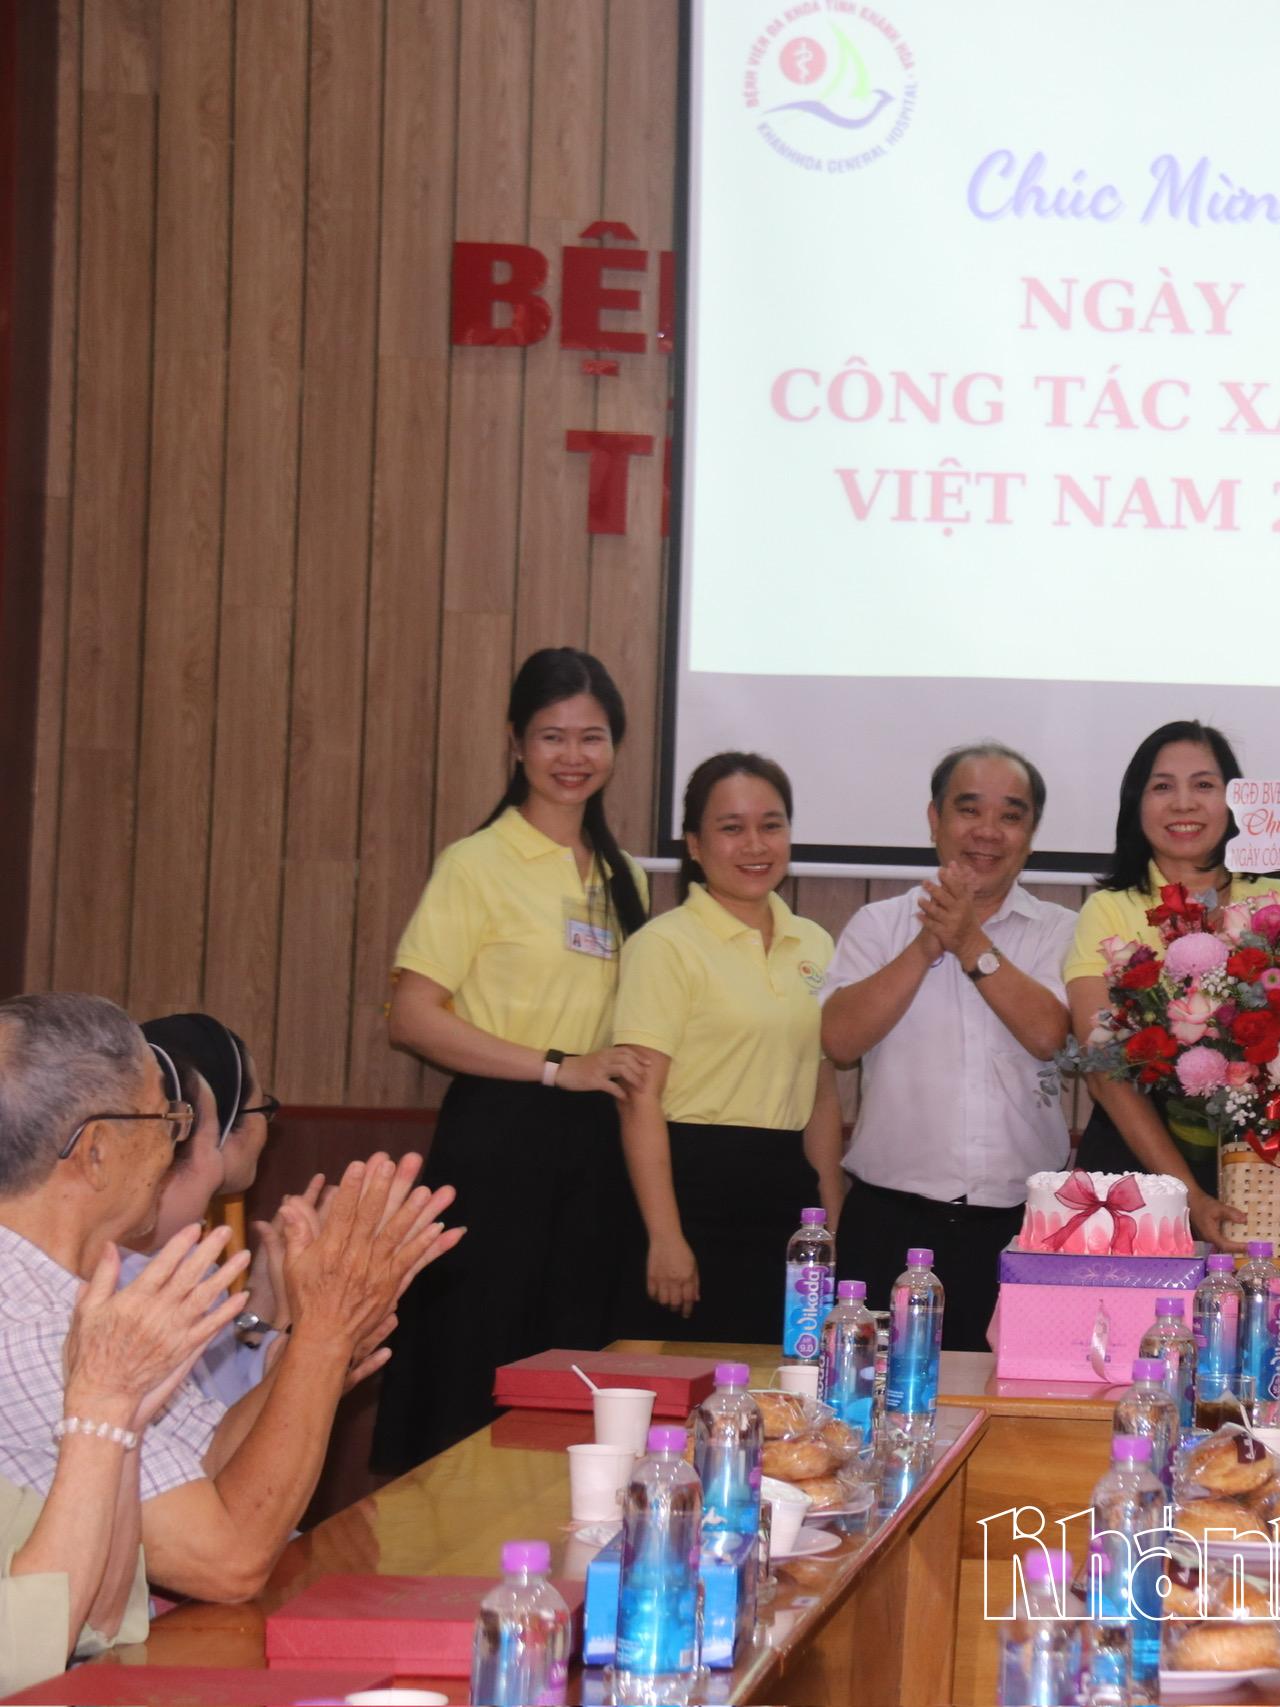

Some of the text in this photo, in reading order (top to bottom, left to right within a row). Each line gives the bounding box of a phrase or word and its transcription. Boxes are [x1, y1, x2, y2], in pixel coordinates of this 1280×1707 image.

[827, 144, 887, 174] GENERAL
[884, 81, 919, 146] HOSPITAL
[966, 148, 1125, 225] Chúc
[1020, 268, 1245, 336] NGÀY
[770, 356, 1004, 426] CÔNG
[1034, 365, 1192, 432] TÁC
[834, 458, 1026, 538] VIỆT
[1052, 473, 1242, 533] NAM
[1233, 781, 1259, 805] BGĐ
[1231, 843, 1260, 866] NGÀY
